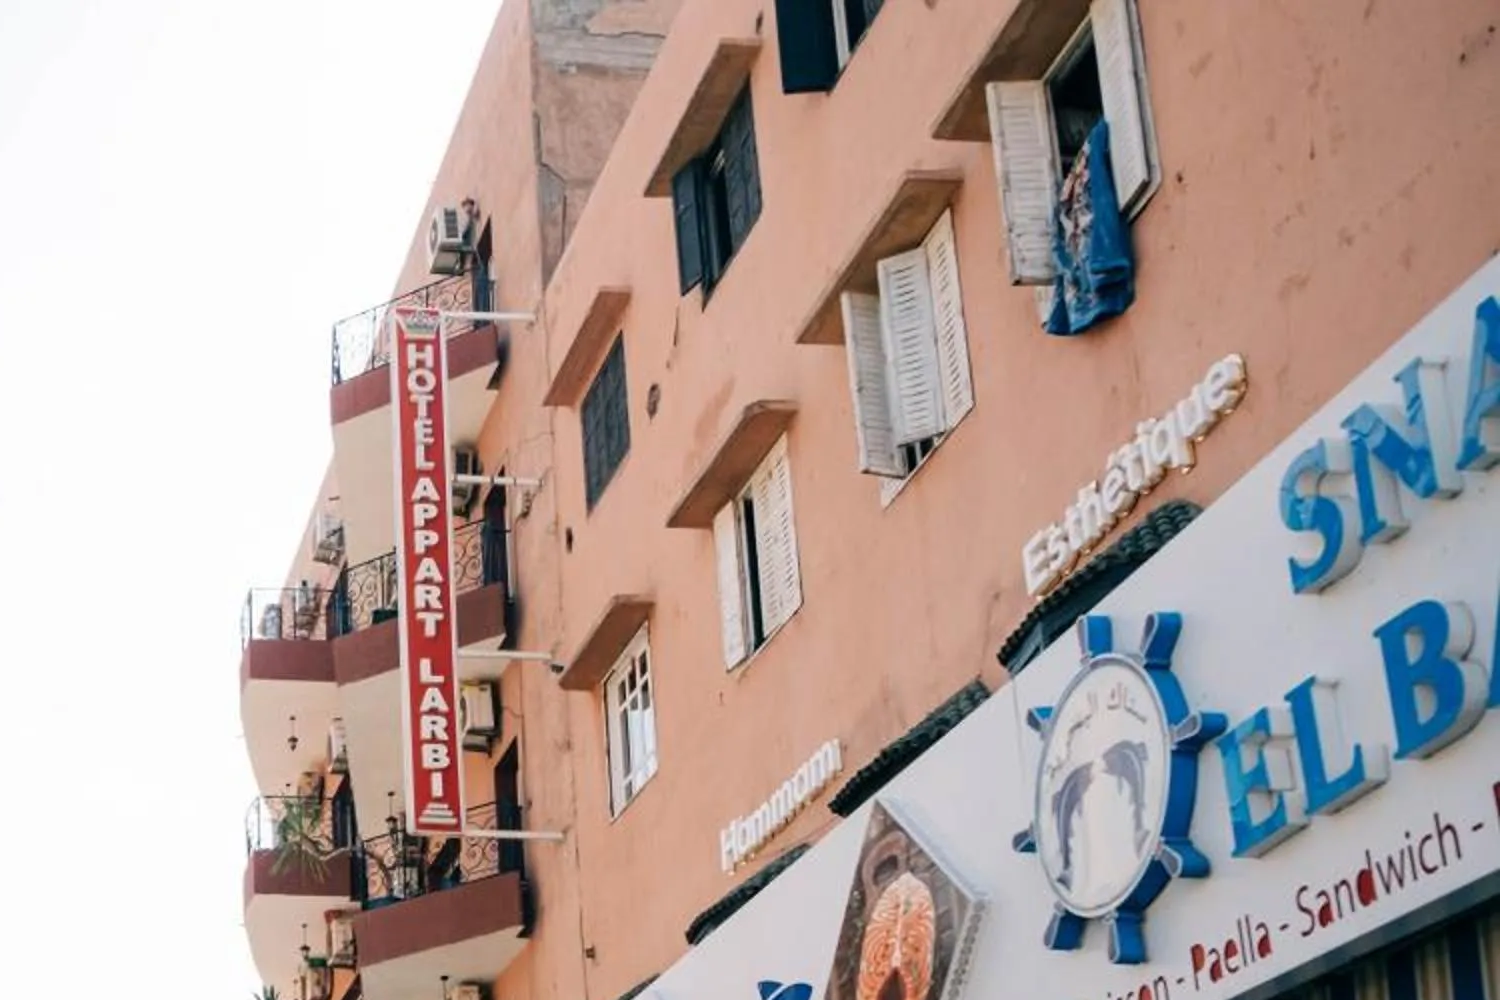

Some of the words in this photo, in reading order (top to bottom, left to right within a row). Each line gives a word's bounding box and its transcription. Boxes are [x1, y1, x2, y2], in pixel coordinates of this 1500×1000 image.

[407, 343, 437, 471] HOTEL
[1023, 352, 1248, 598] Esthétique
[411, 477, 444, 637] APPART
[419, 657, 450, 798] LARBI
[1217, 675, 1380, 859] EL
[1373, 565, 1500, 761] B
[1189, 914, 1274, 991] Paella
[1296, 812, 1463, 939] Sandwich
